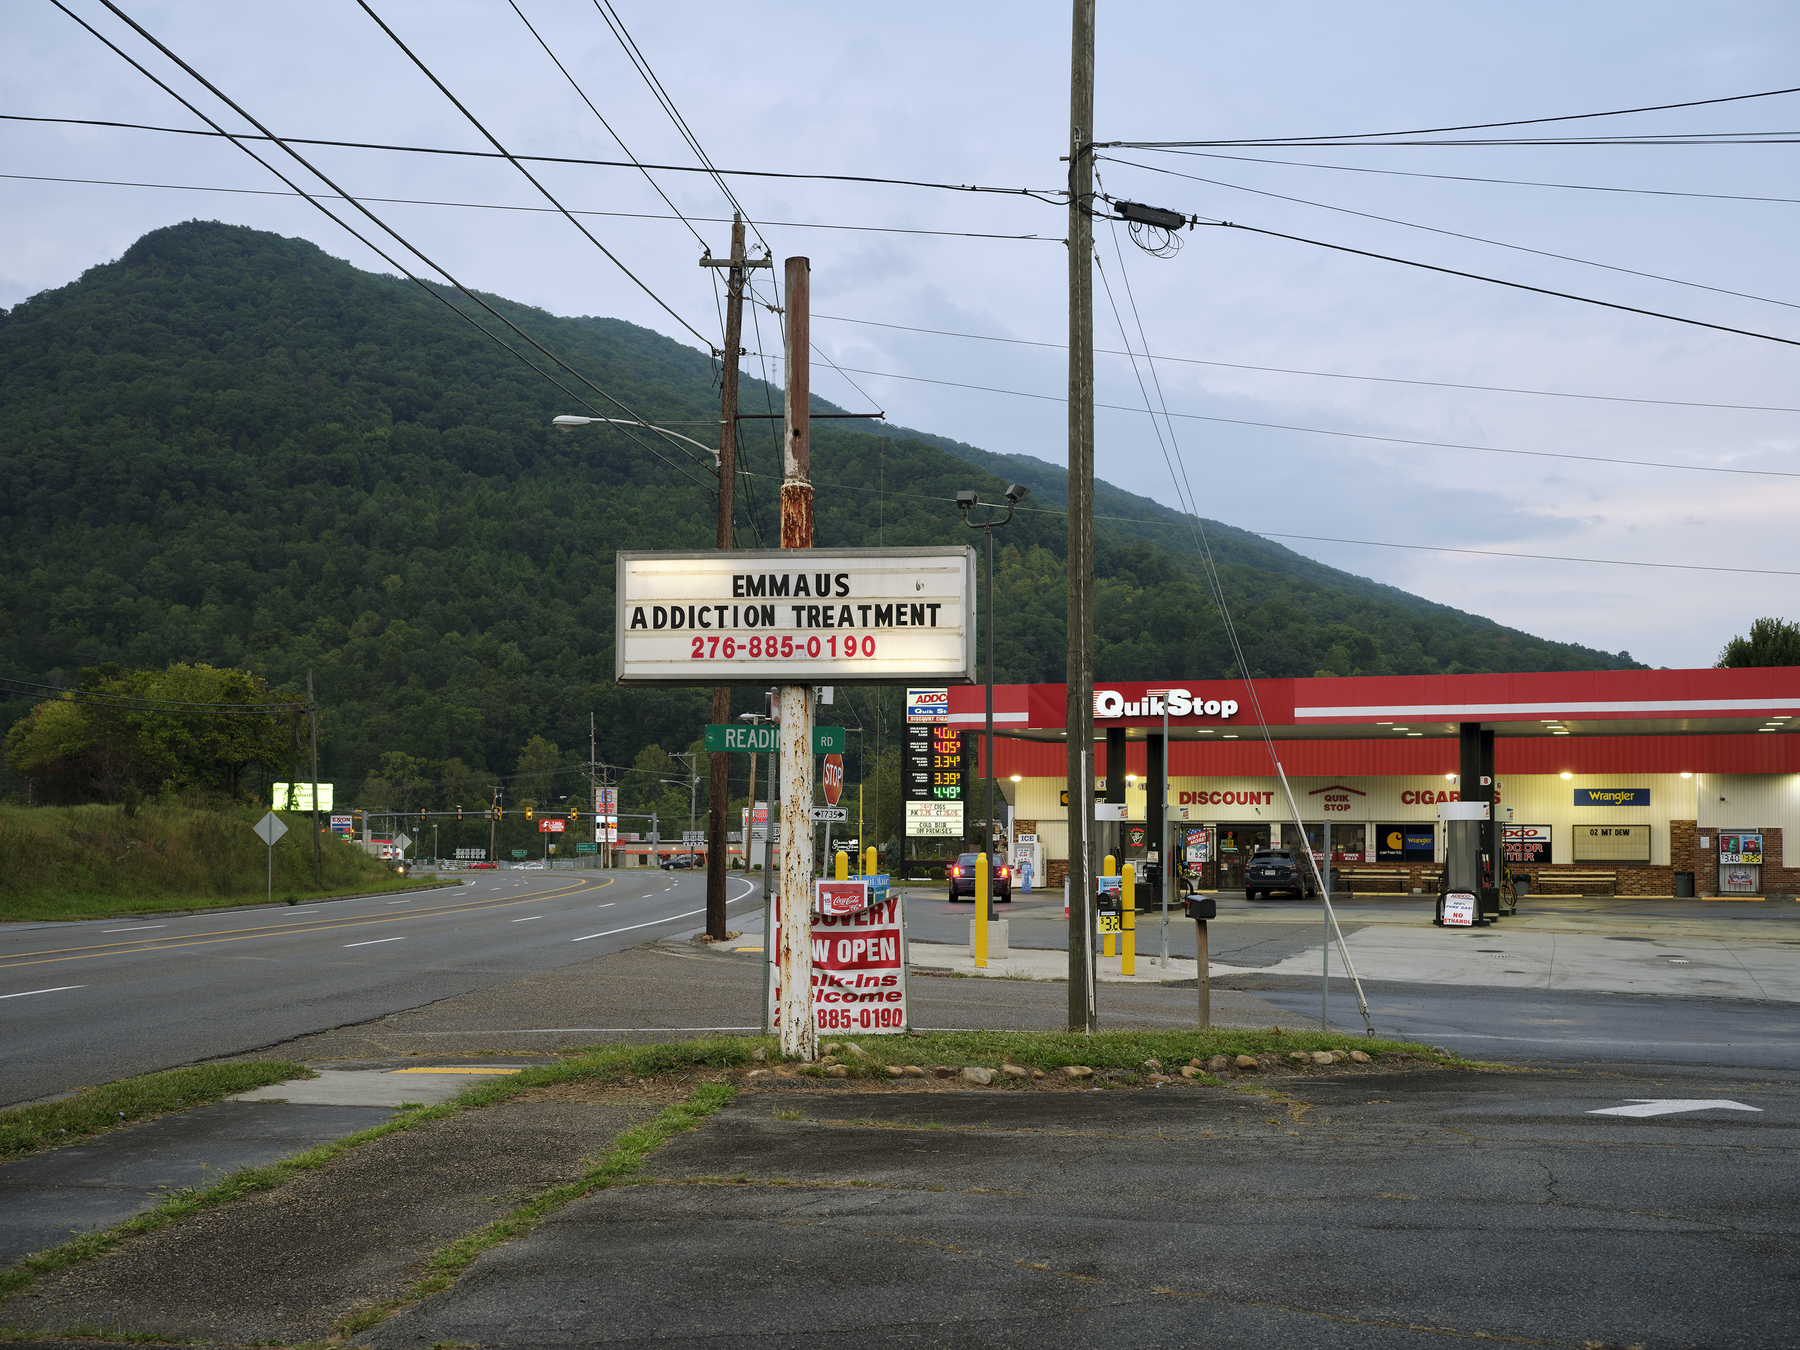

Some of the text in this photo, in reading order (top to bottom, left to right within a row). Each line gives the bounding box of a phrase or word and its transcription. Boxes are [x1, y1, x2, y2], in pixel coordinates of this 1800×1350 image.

[732, 573, 850, 598] EMMAUS
[630, 603, 942, 630] ADDICTION TREATMENT
[691, 635, 876, 659] 276-885-0190
[916, 694, 948, 704] ADDC
[820, 736, 833, 747] RD
[825, 764, 842, 787] STOP
[1179, 791, 1274, 805] DISCOUNT
[1324, 794, 1349, 803] QUIK
[1589, 791, 1635, 804] Wrangler
[1407, 837, 1432, 845] Wrangler
[1503, 843, 1543, 852] DOOR
[1101, 917, 1120, 930] $3.2
[837, 937, 896, 962] OPEN
[812, 974, 898, 988] alk-Ins
[817, 1008, 902, 1029] 885-0190
